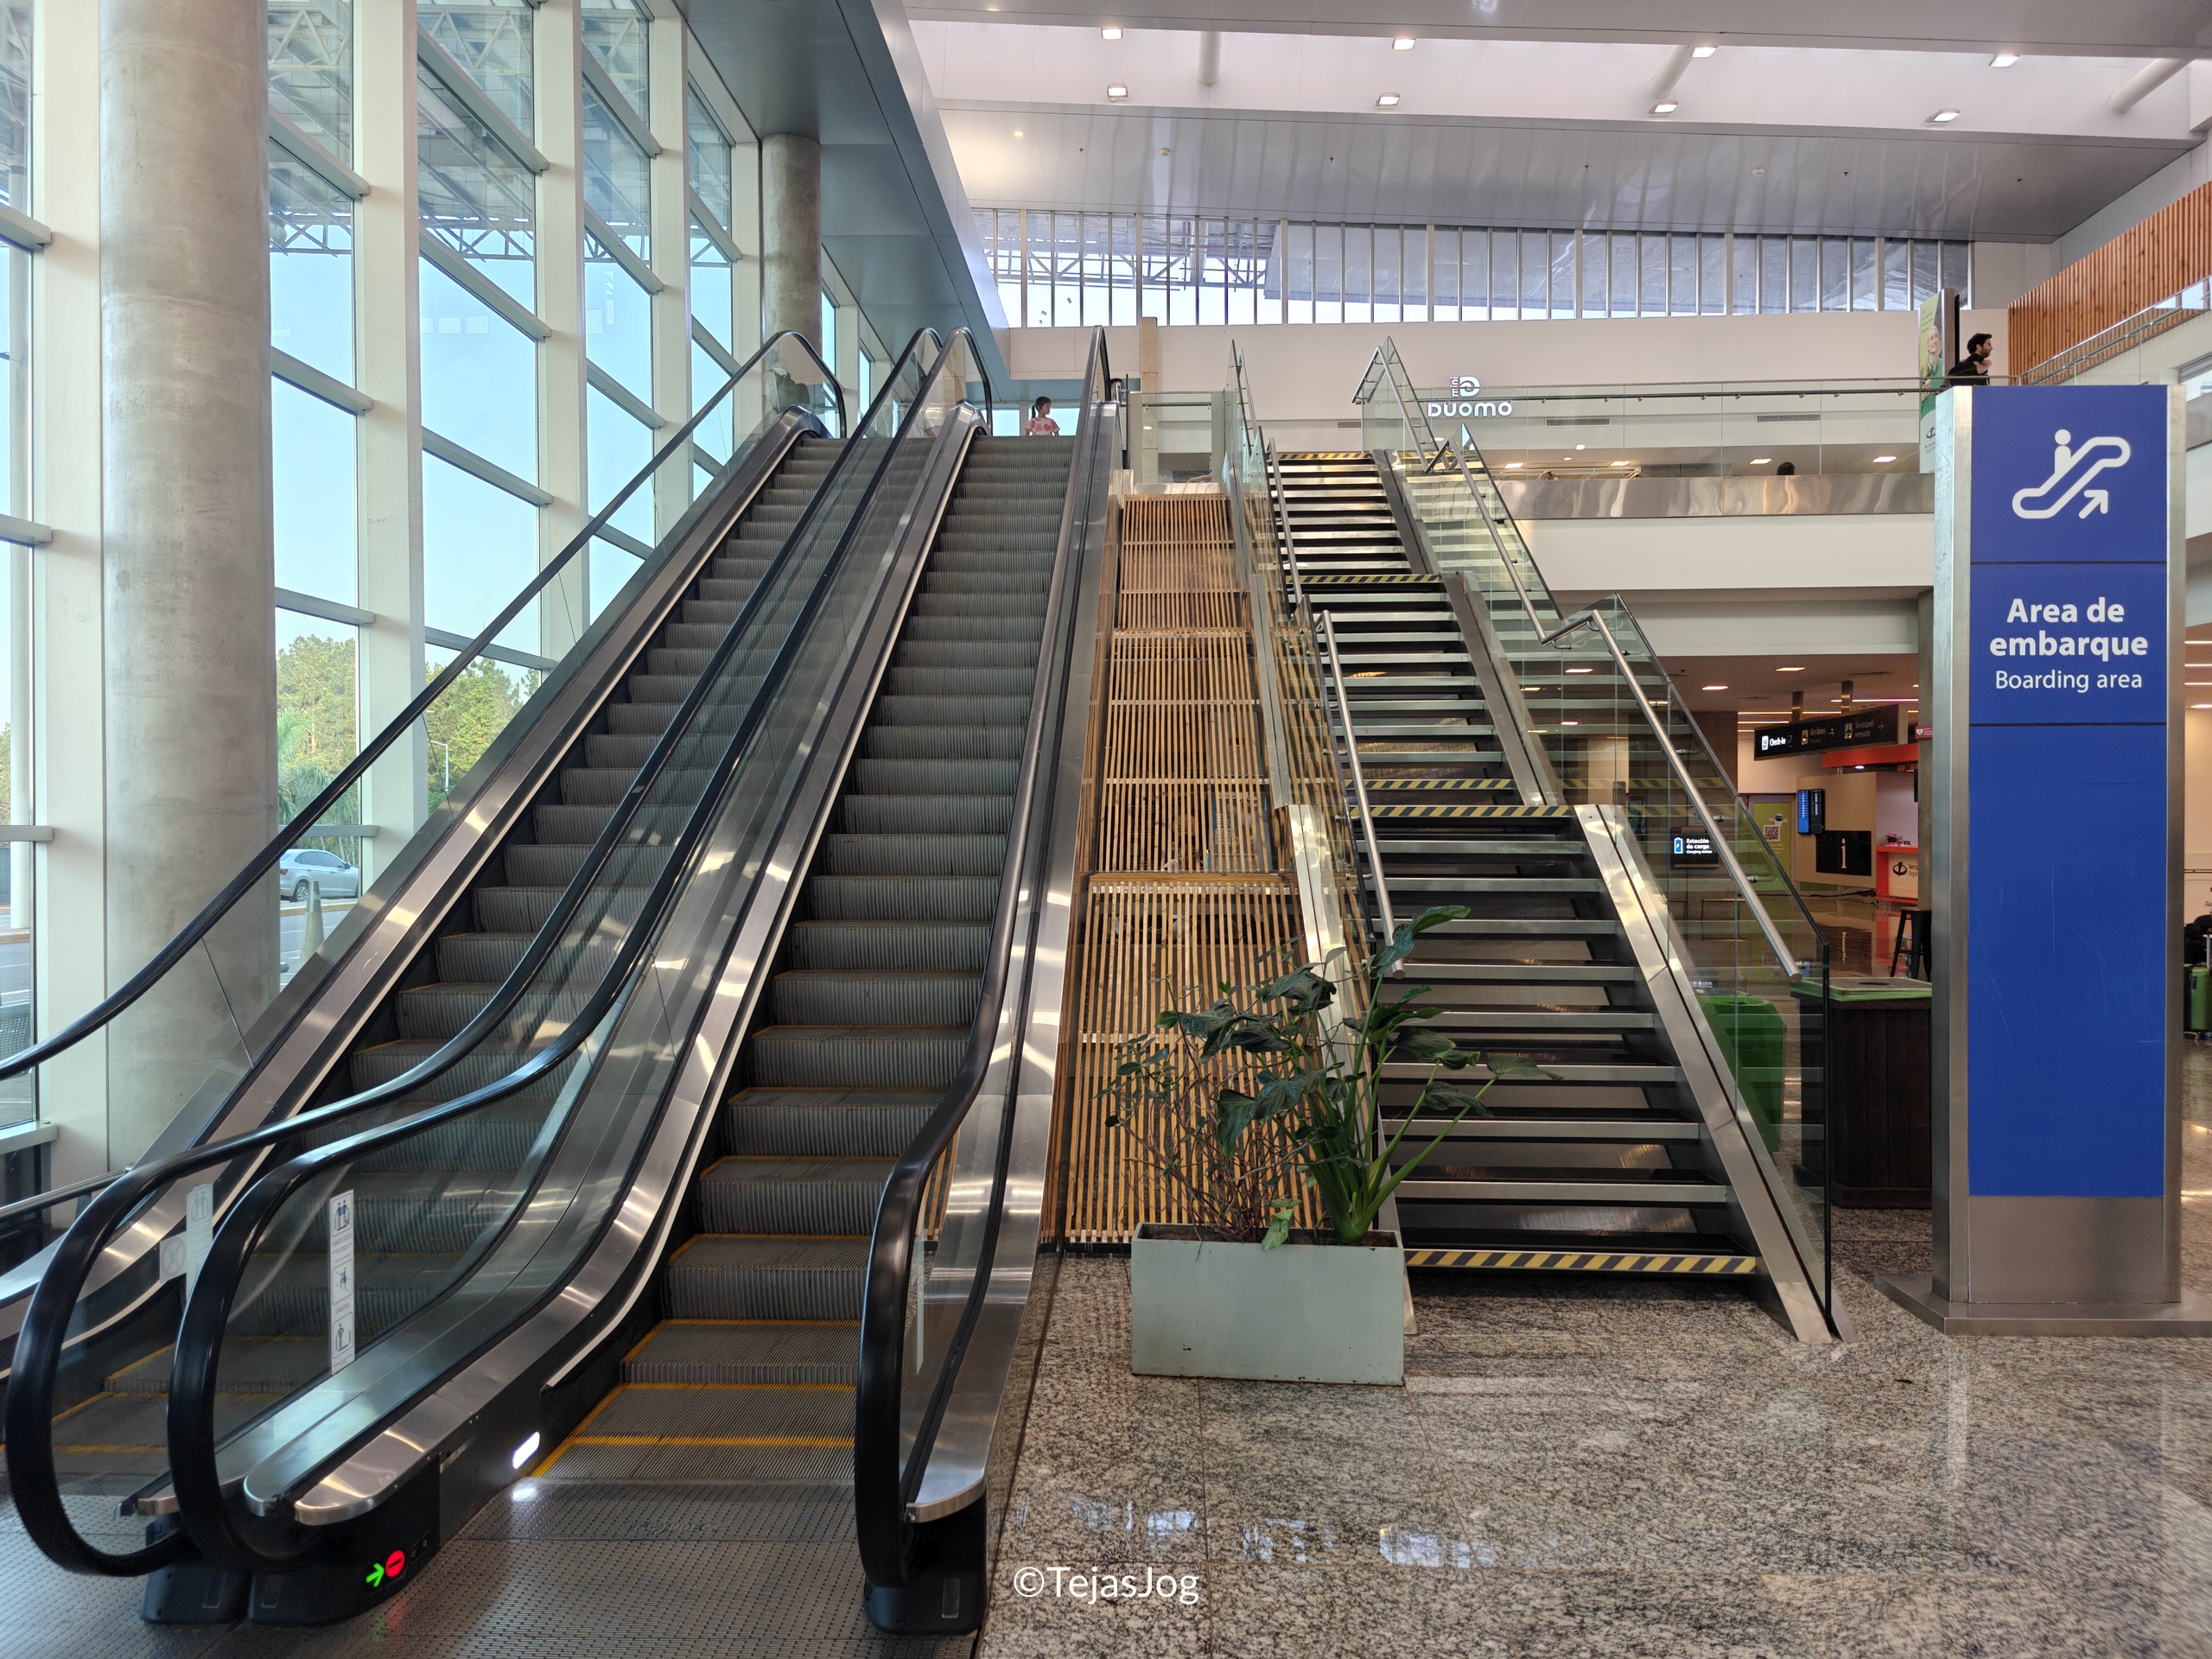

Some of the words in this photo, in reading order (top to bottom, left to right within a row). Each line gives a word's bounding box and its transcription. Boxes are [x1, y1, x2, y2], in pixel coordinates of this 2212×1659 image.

[1427, 402, 1512, 416] DUOMO
[2006, 598, 2077, 623] Area
[2086, 596, 2124, 623] de
[1990, 630, 2148, 662] embarque
[1995, 670, 2089, 694] Boarding
[2096, 673, 2142, 689] area
